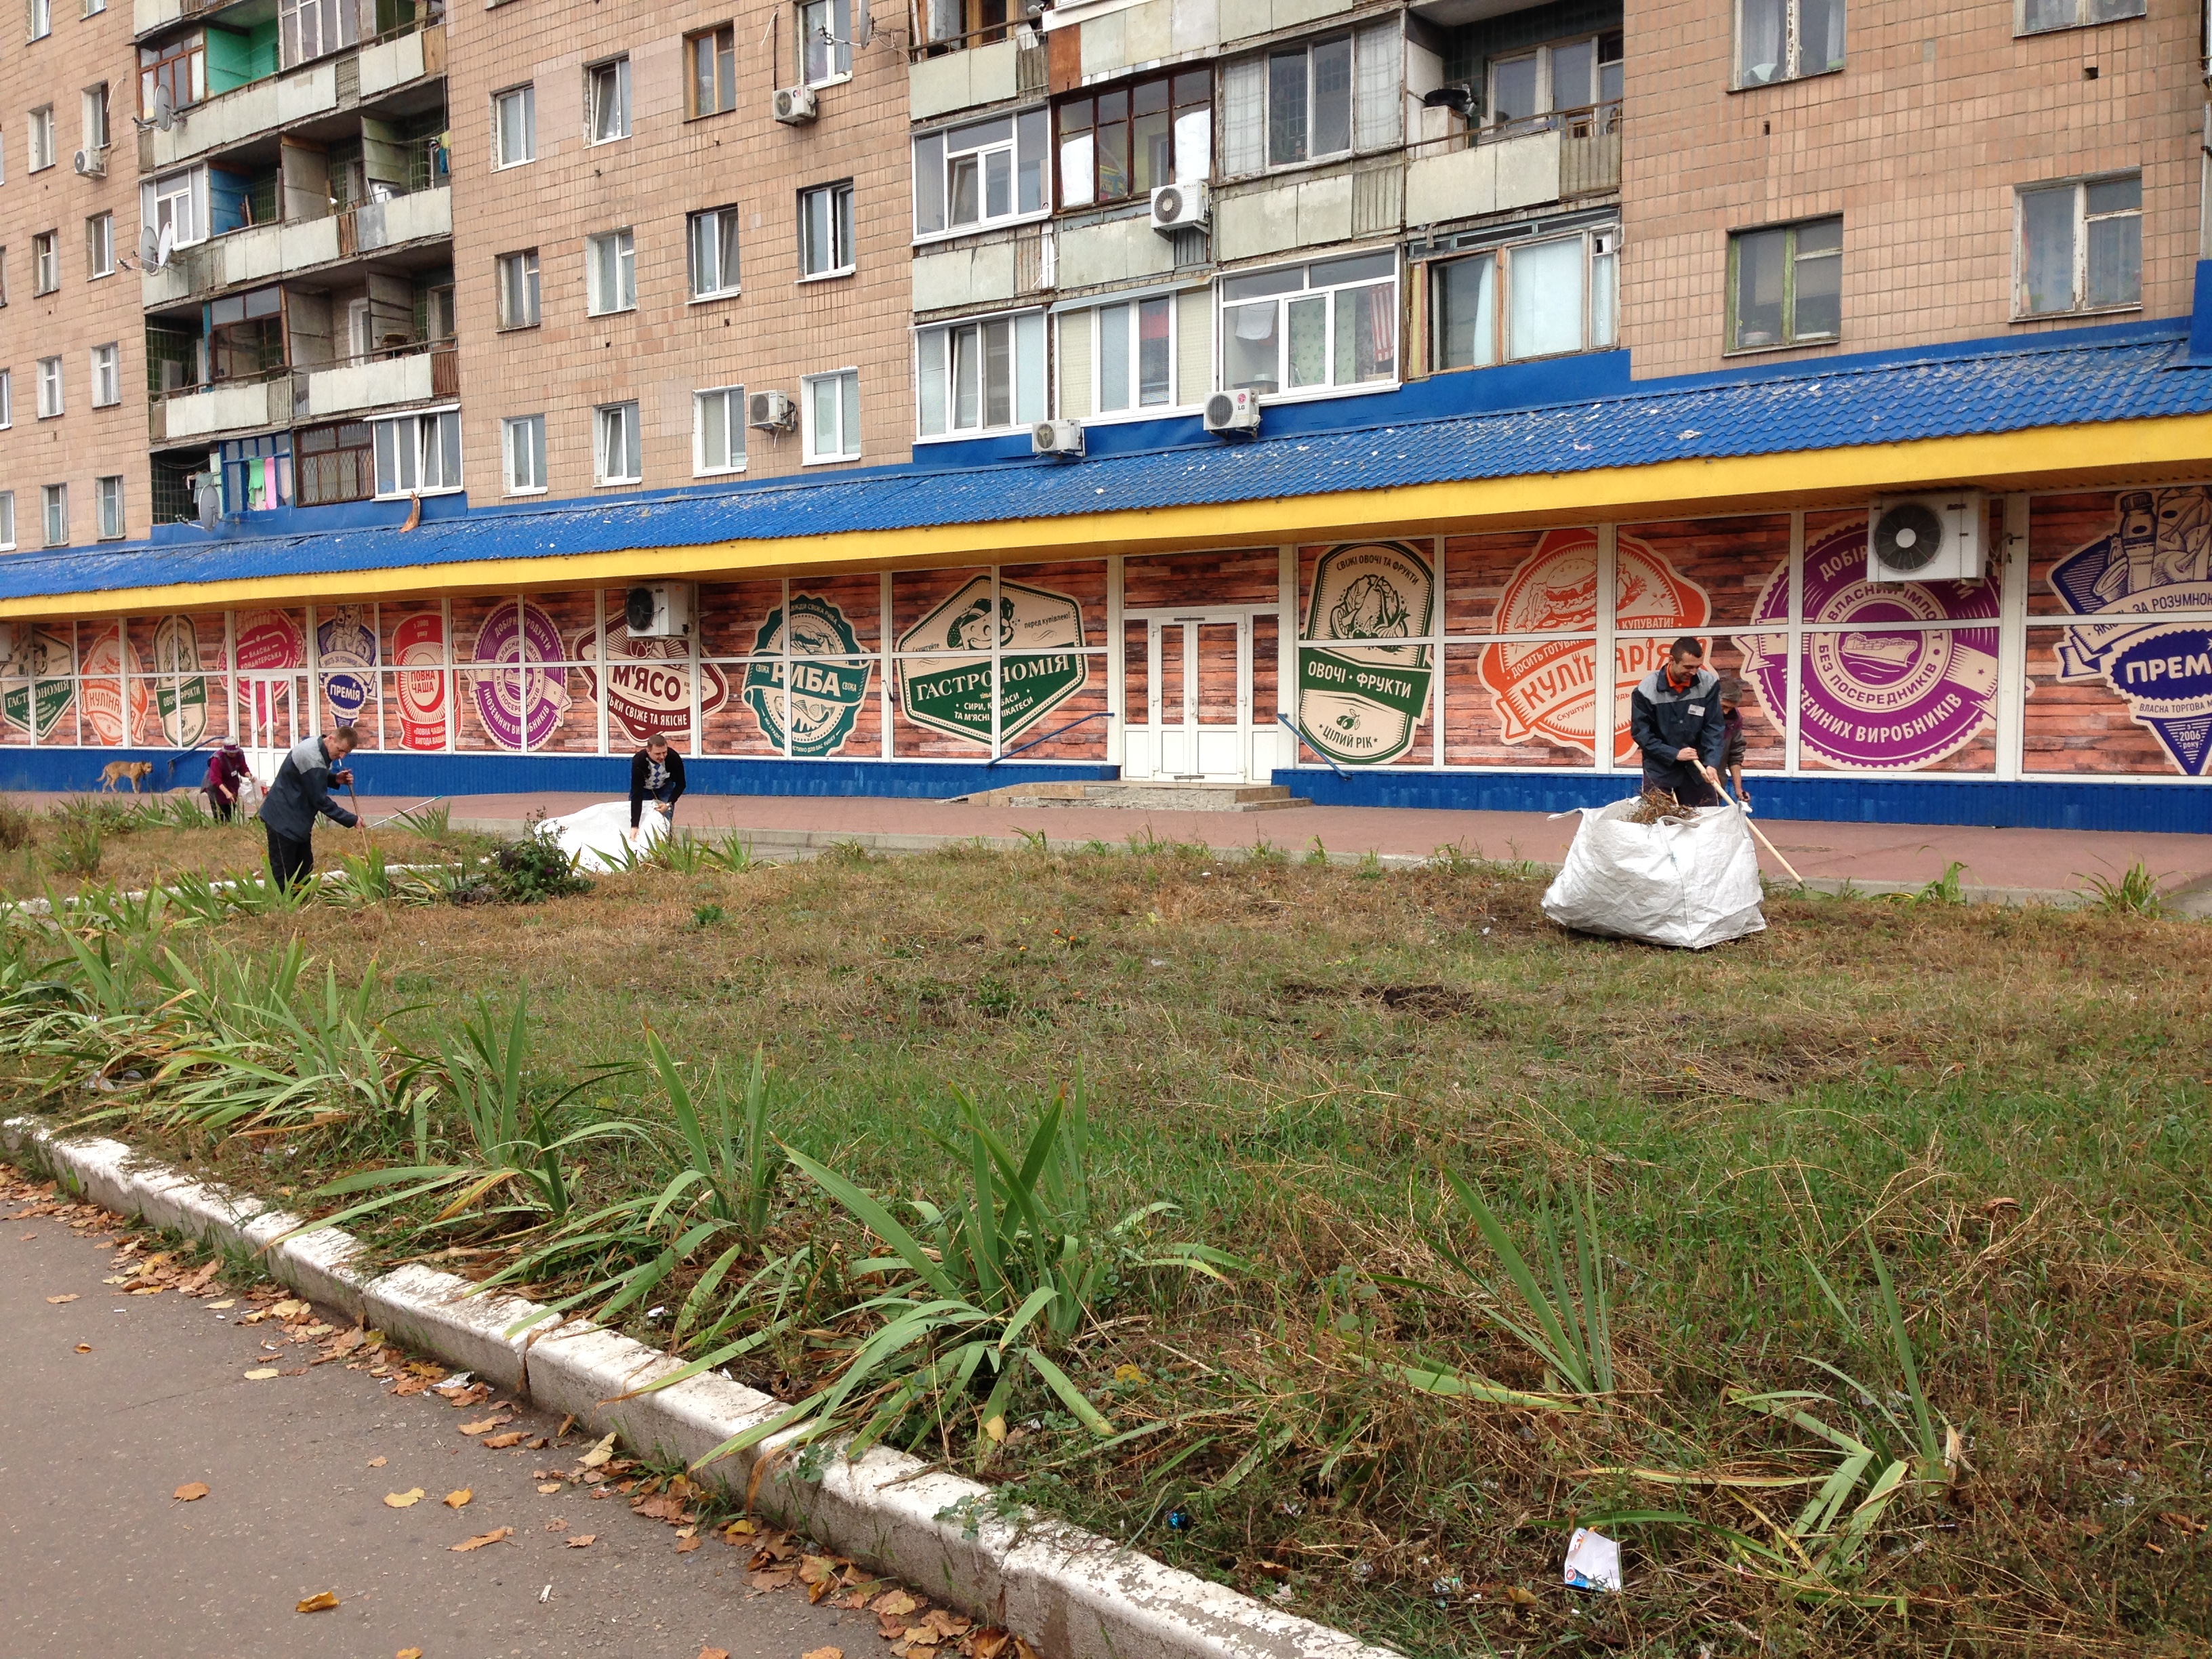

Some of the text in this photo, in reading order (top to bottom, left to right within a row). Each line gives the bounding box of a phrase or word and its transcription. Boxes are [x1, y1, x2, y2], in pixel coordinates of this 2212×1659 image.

[1336, 554, 1420, 586] СВІЖІ ОВОЧІ ТА ФРУКТИ
[1818, 544, 1868, 581] ДОБІР
[1903, 589, 1944, 640] ІМПОТ
[2133, 602, 2149, 613] ЗА
[495, 616, 552, 651] ДОБІРН РОДУКТИ
[1024, 619, 1042, 630] перед
[1622, 617, 1674, 629] КУПУВАТИ!
[499, 640, 541, 674] ВЛАСНИ ІМПОТ
[1512, 639, 1587, 680] ДОСИТЬ ГОТУВ
[411, 671, 435, 682] ПОВНА
[612, 665, 681, 702] М'ЯСО
[771, 662, 841, 697] РИБА
[1308, 661, 1412, 699] ОВОЧІ ФРУКТИ
[1819, 644, 1938, 705] БЕЗ ПОСЕРЕДНИКІВ
[7, 680, 69, 709] ГАСТОНОМІЯ
[330, 684, 361, 701] ПРЕМІЯ
[411, 680, 434, 694] ЧАША
[1614, 693, 1630, 702] удь
[484, 688, 550, 735] ІНОЗЕМНИХ ВИОБНИКІВ
[501, 687, 540, 712] ПОСЕРЕНИКІВ
[964, 702, 986, 711] СИРИ,
[987, 692, 1020, 709] КБАСИ
[2139, 703, 2169, 714] ВЛАСНА
[2172, 702, 2205, 713] ТОРГОВА
[625, 705, 648, 723] СВІЖЕ
[650, 713, 658, 725] ТА
[660, 714, 688, 726] ЯКІСНЕ
[954, 711, 963, 720] ТА
[964, 714, 990, 722] М'ЯСНІ
[1855, 693, 1963, 743] ВИРОБНИКІВ
[1323, 726, 1373, 749] ЦІЛИЙ РІК
[2179, 731, 2201, 742] 2006
[2183, 741, 2199, 750] року
